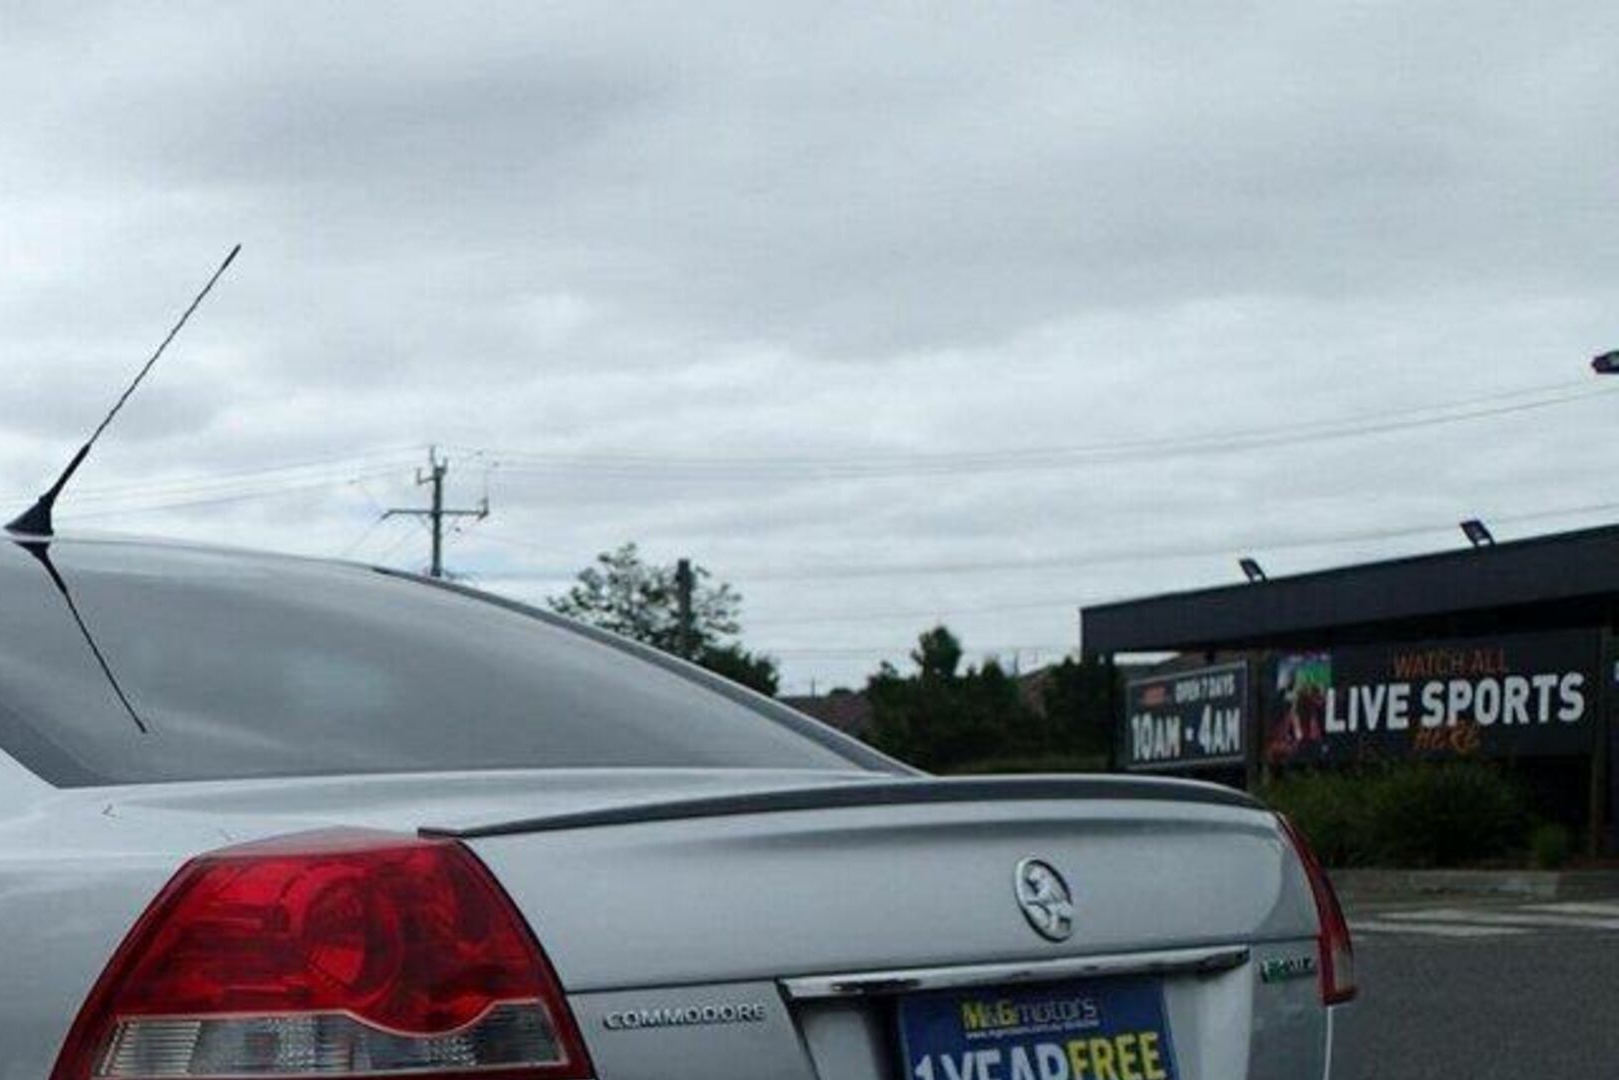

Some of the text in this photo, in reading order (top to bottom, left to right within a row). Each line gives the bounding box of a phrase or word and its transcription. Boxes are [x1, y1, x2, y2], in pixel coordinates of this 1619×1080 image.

[1394, 649, 1505, 678] WATCH ALL
[1325, 672, 1585, 733] LIVE SPORTS
[1132, 712, 1181, 761] 10AM
[1198, 704, 1241, 755] 4AM
[604, 1004, 766, 1029] COMMODORE
